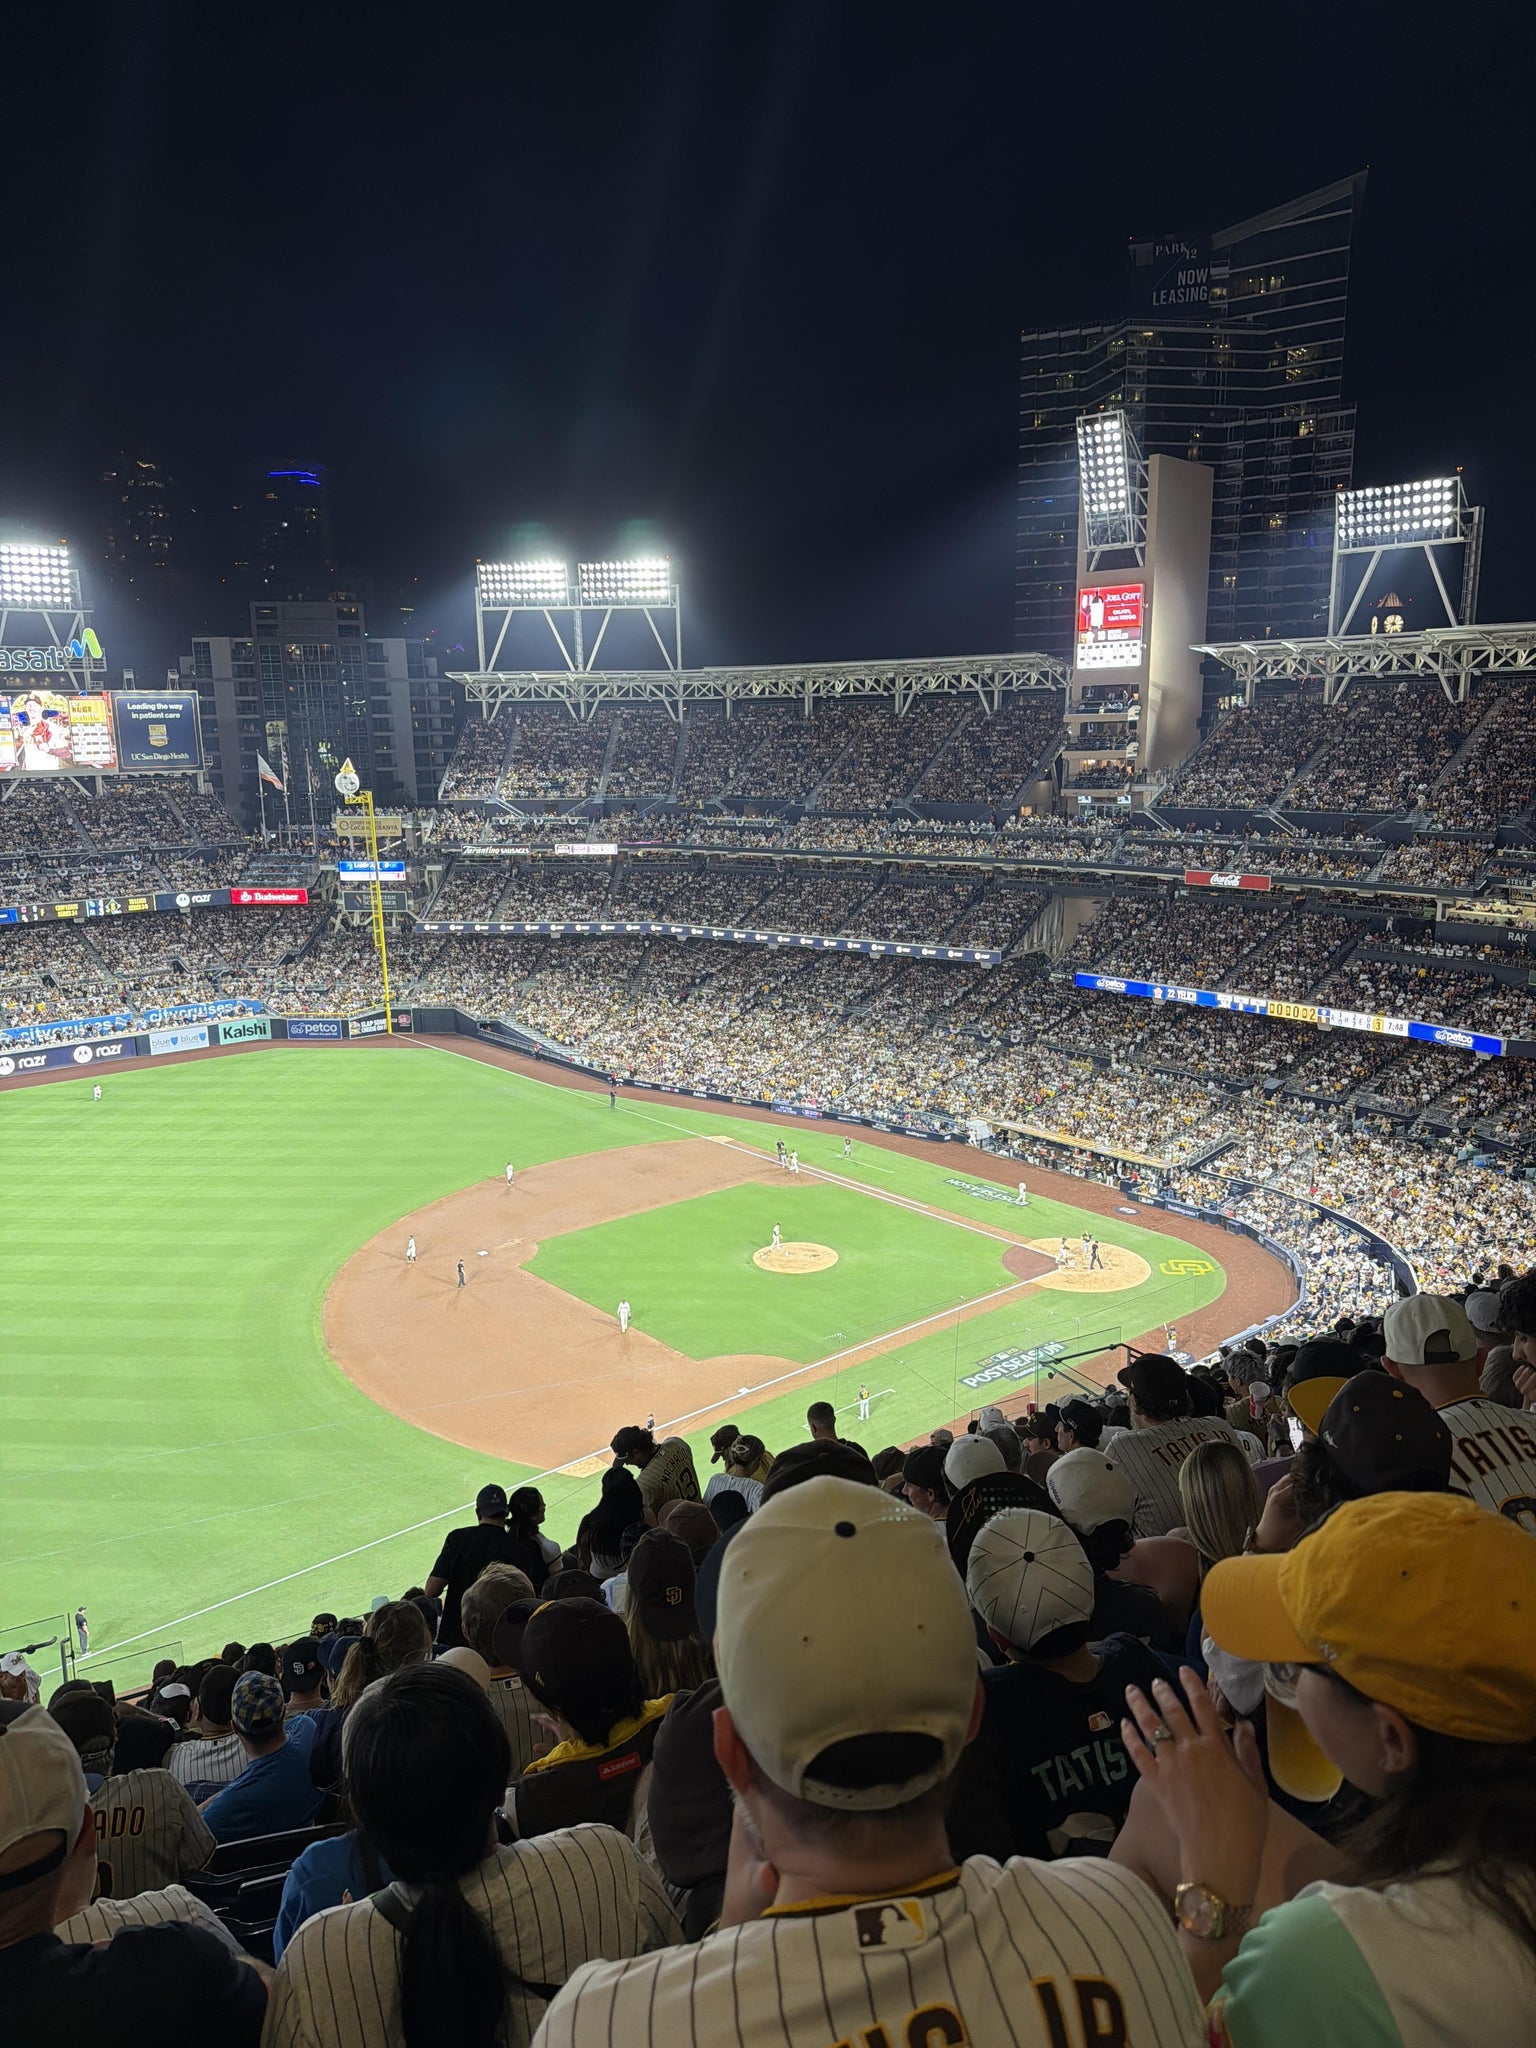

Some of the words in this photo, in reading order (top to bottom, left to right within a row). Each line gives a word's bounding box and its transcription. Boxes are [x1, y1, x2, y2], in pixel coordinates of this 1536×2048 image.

[1155, 242, 1188, 256] PARK
[1177, 268, 1208, 286] NOW
[1152, 285, 1208, 306] LEASING
[127, 702, 156, 711] Leading
[156, 702, 169, 710] the
[139, 712, 164, 720] patient
[141, 752, 154, 760] San
[153, 752, 171, 761] Diego
[170, 752, 190, 760] Health
[463, 844, 500, 855] Tarantino
[254, 892, 299, 901] Budweiser
[1507, 931, 1529, 943] RAK
[1167, 988, 1176, 998] 22
[1177, 990, 1197, 1001] YELICH
[1309, 1008, 1316, 1021] 2
[223, 1022, 267, 1039] Kalshi
[305, 1022, 338, 1033] petco
[1375, 1021, 1381, 1031] 3
[152, 1038, 171, 1047] blue
[180, 1034, 199, 1042] blue
[1446, 1032, 1474, 1044] petco
[96, 1044, 123, 1057] razr
[18, 1055, 47, 1069] razr
[660, 1448, 688, 1485] MACHADO
[675, 1466, 699, 1500] 13
[1030, 1738, 1128, 1802] TATIS
